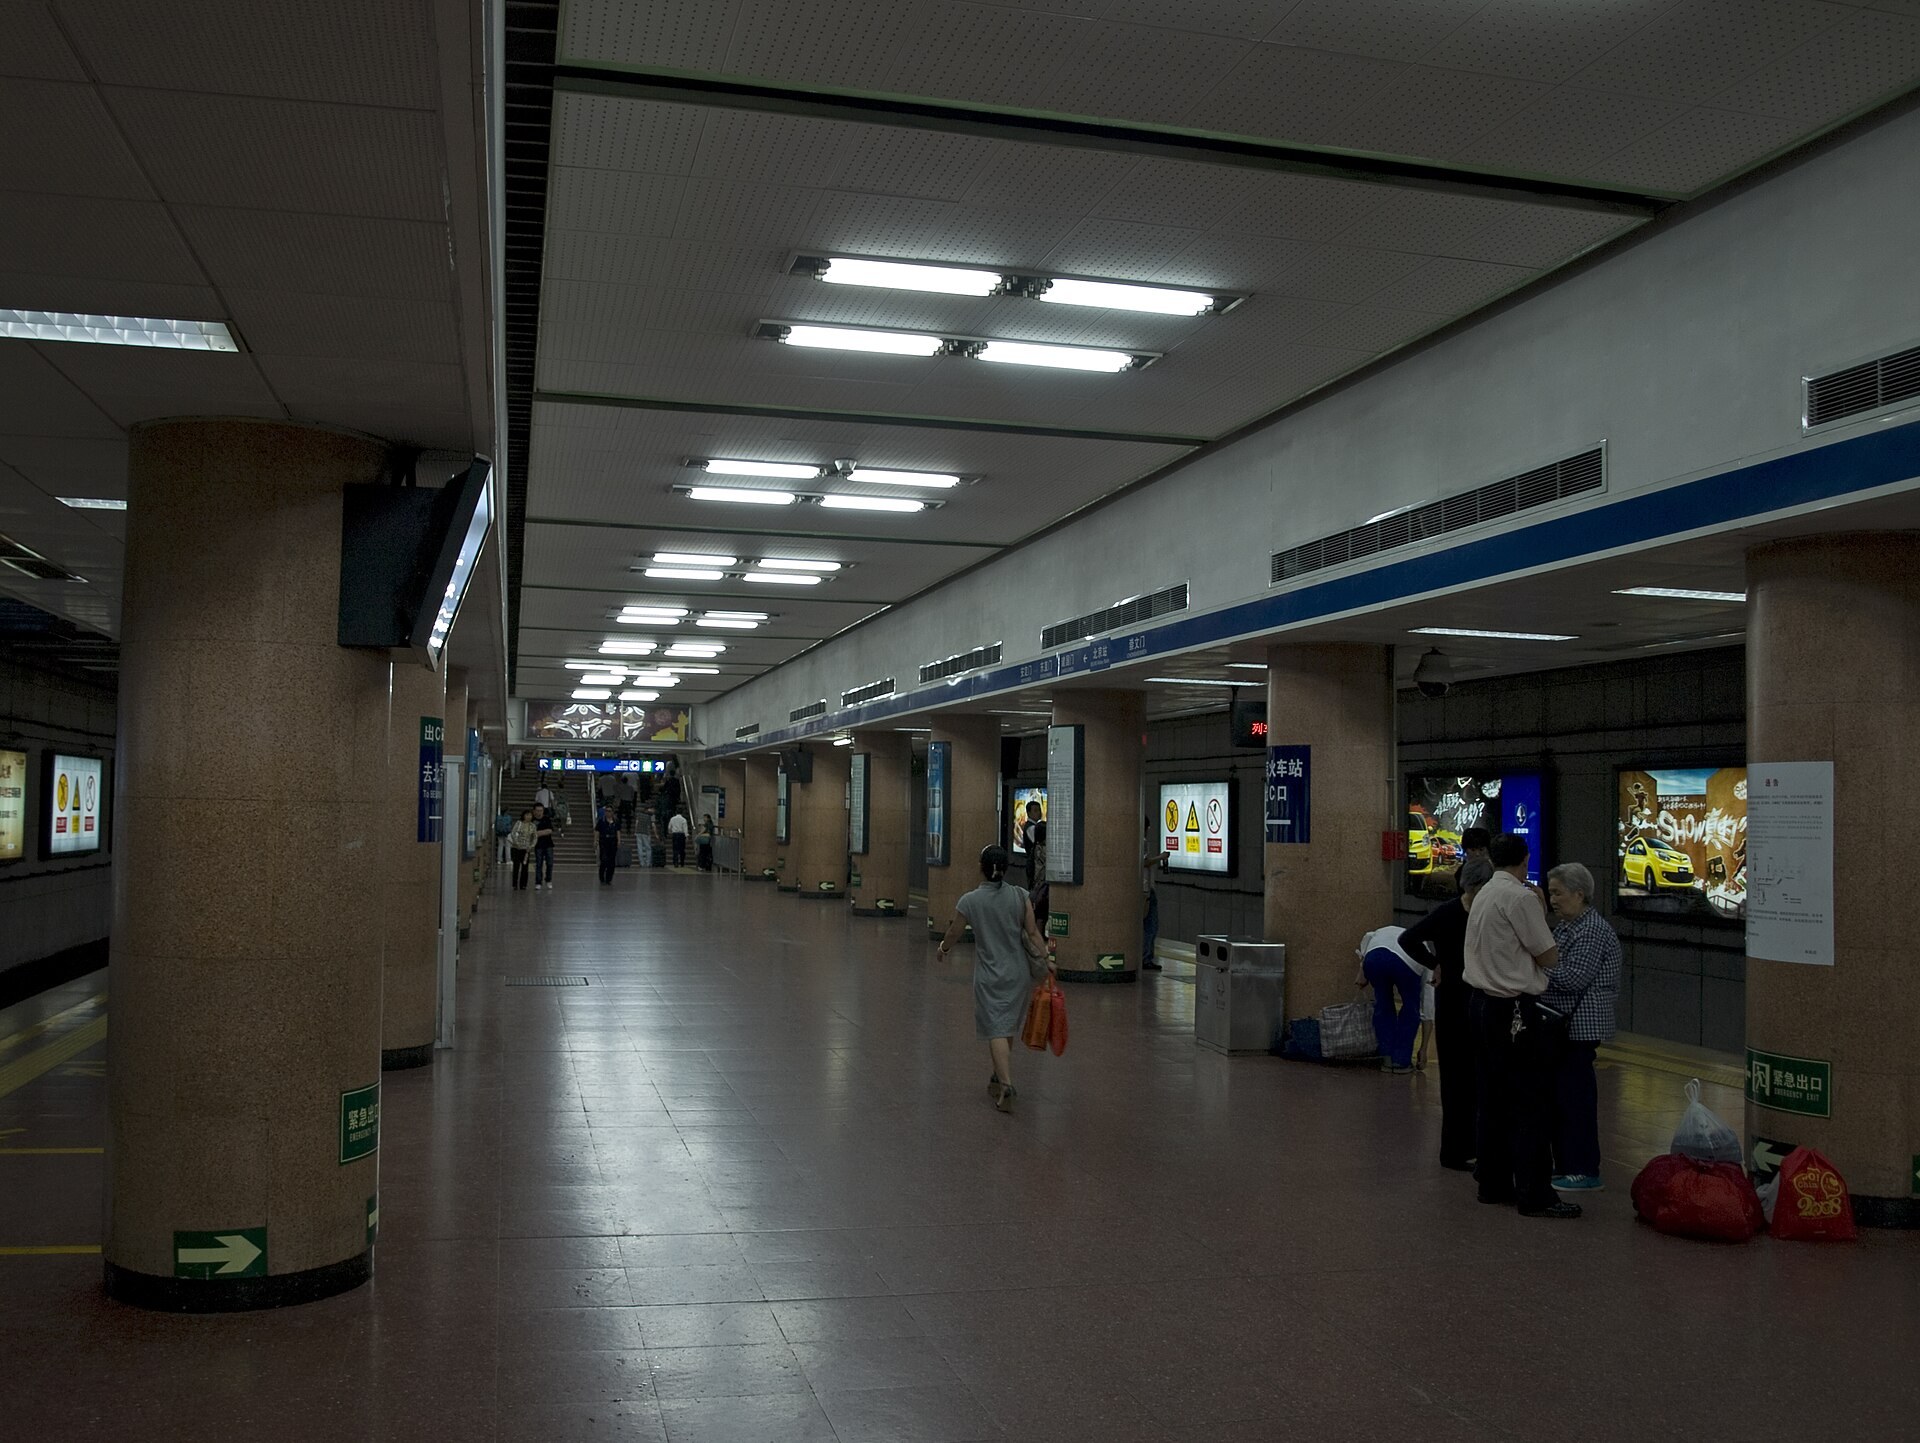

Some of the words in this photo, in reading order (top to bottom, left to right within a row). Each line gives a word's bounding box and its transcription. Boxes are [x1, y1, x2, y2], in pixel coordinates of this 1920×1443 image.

[1093, 646, 1108, 659] 北京站
[1128, 635, 1146, 651] 崇文门
[1772, 1069, 1822, 1092] 紧急出口
[1806, 1092, 1820, 1102] EXIT
[1797, 1196, 1841, 1217] 2008
